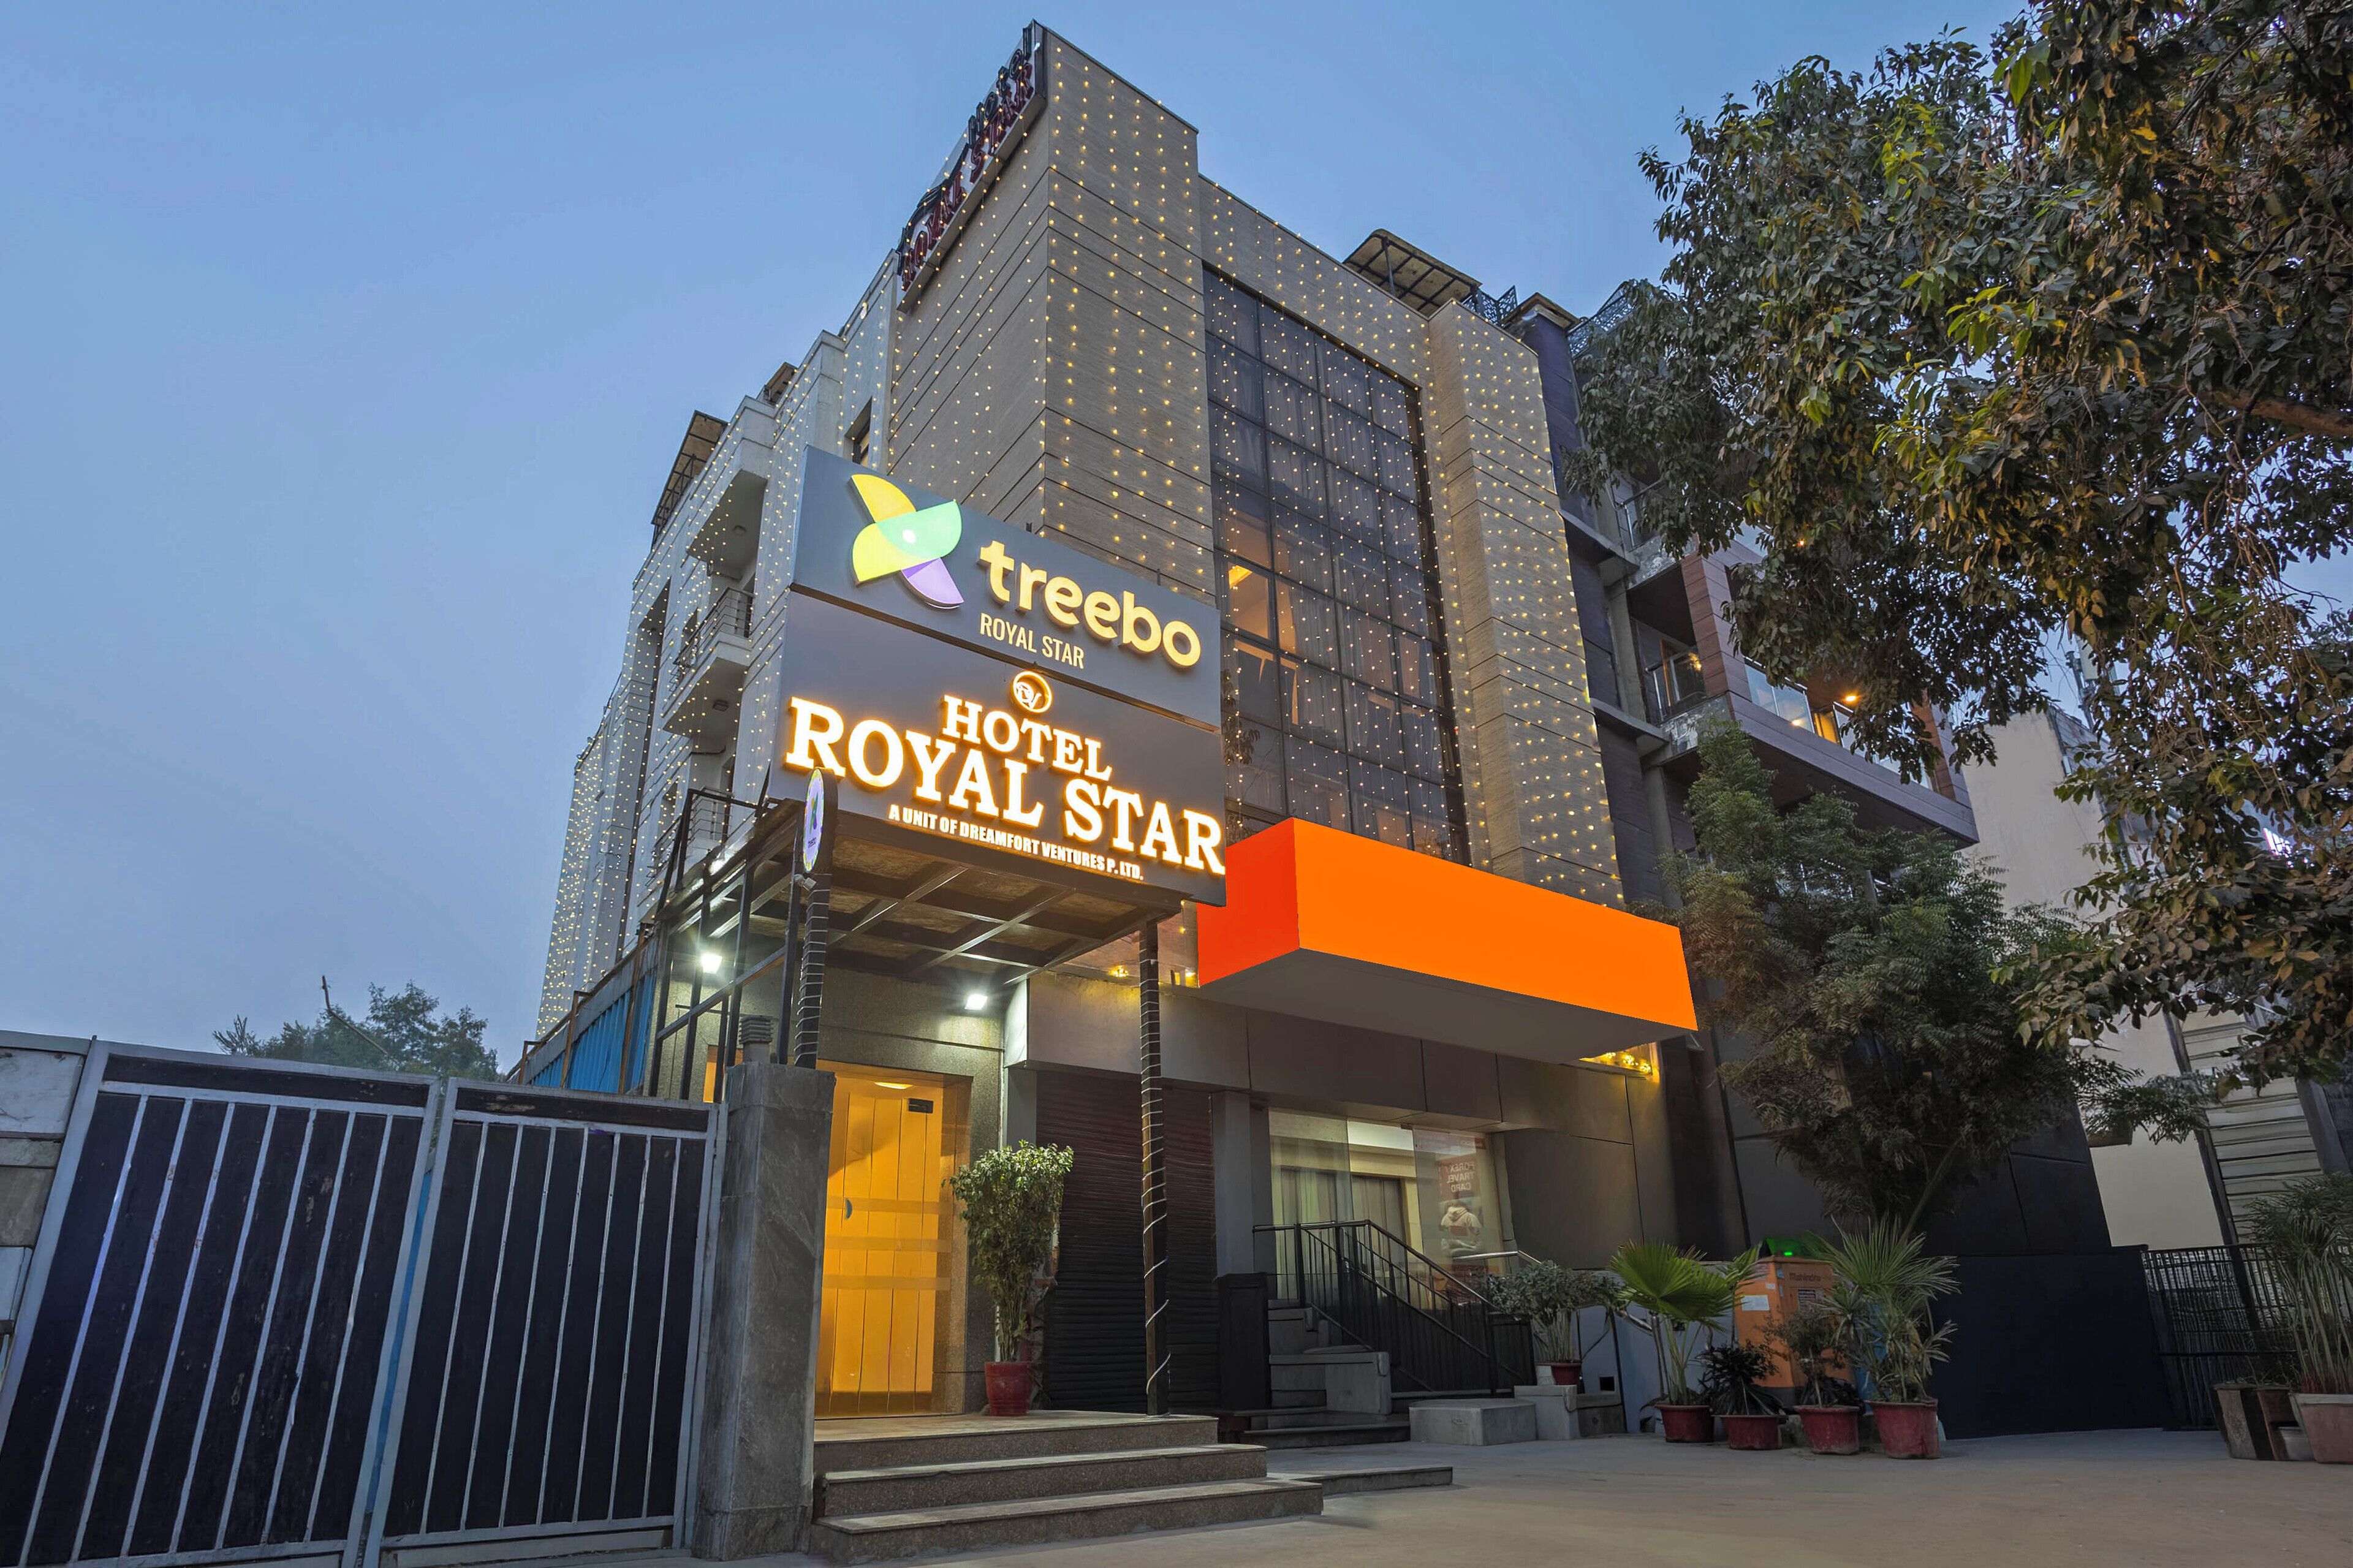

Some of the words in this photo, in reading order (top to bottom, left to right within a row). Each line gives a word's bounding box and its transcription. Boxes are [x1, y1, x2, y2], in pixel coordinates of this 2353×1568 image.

[979, 540, 1202, 667] treebo
[980, 612, 1037, 654] ROYAL
[1042, 635, 1084, 670] STAR
[942, 695, 1113, 781] HOTEL
[785, 697, 1044, 828] ROYAL
[1063, 779, 1226, 874] STAR
[889, 804, 900, 821] A
[903, 807, 938, 830] UNIT
[939, 816, 958, 835] OF
[959, 821, 1040, 855] DREAMFORT
[1041, 841, 1105, 871] VENTURES
[1120, 861, 1144, 881] LTD.
